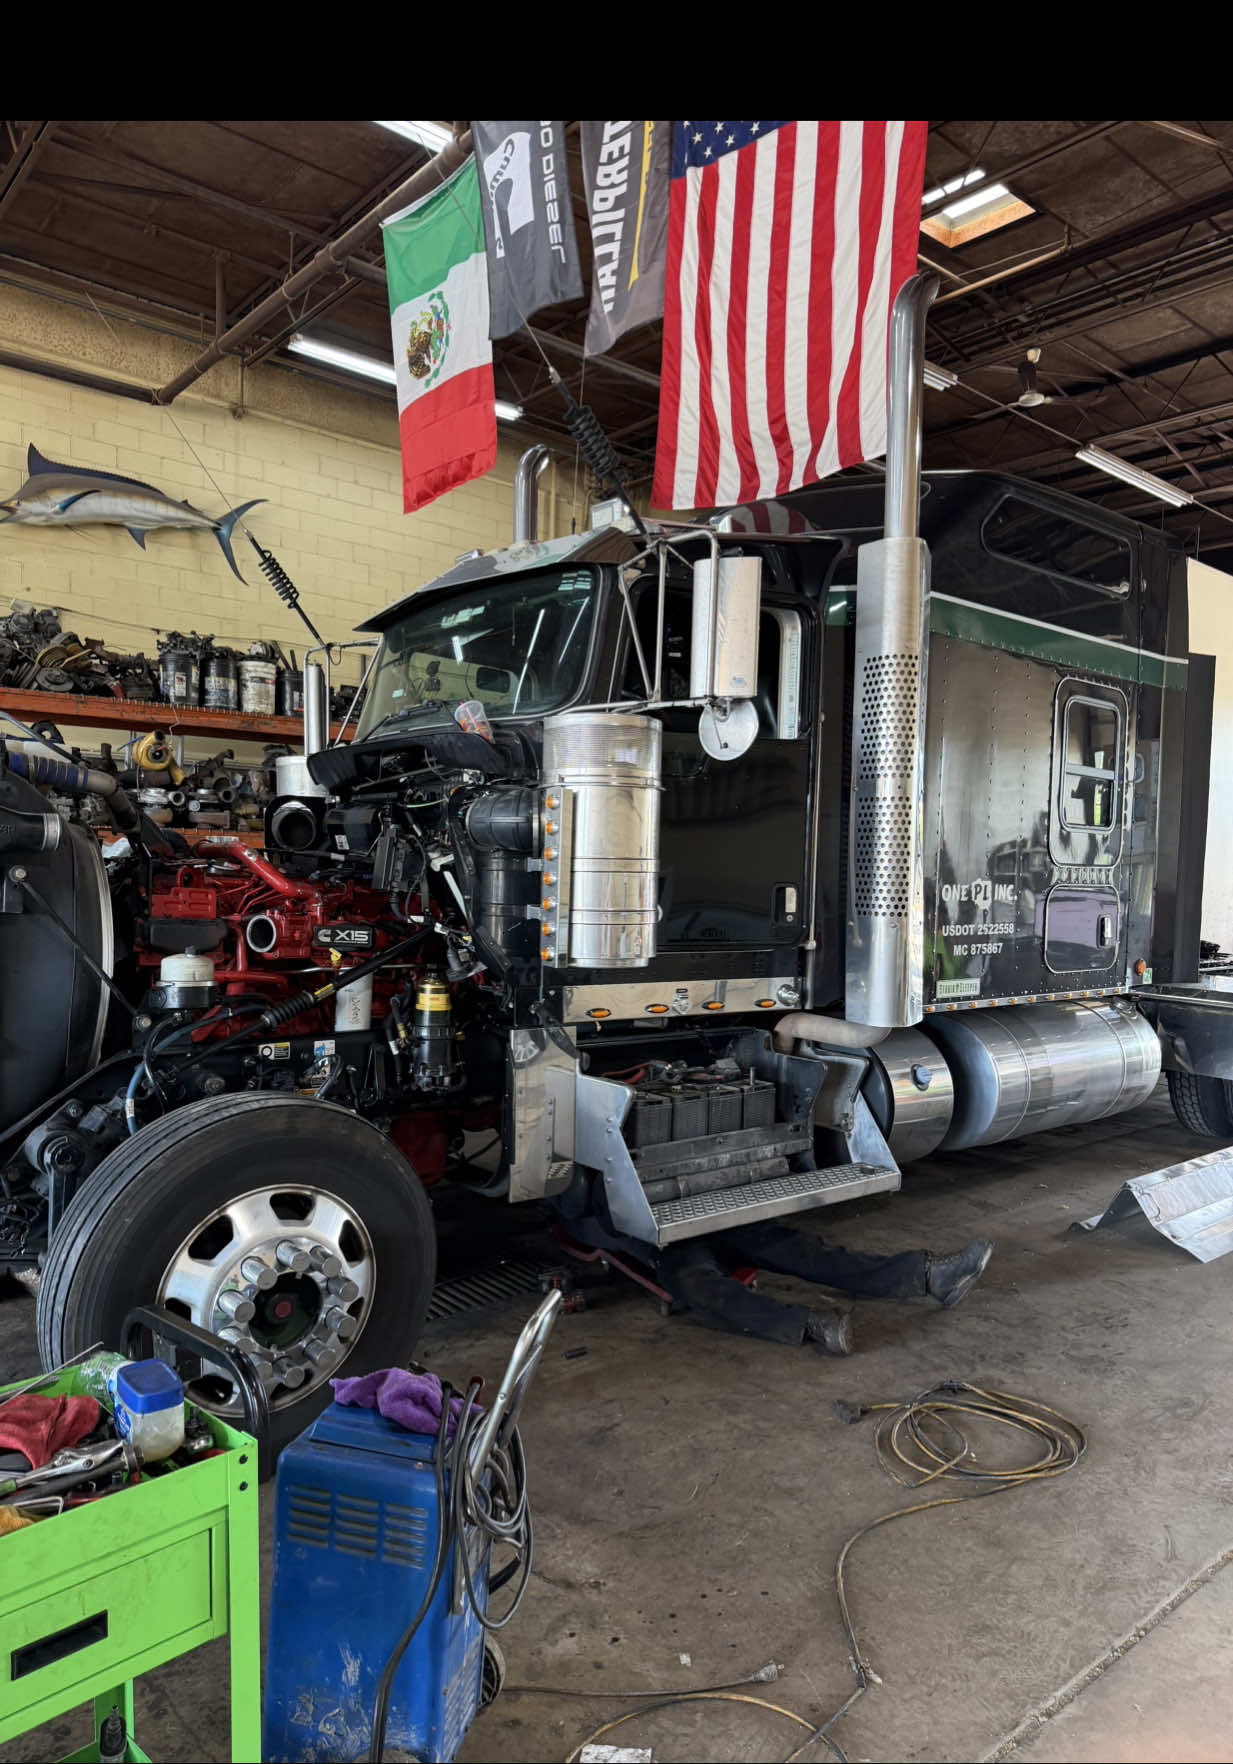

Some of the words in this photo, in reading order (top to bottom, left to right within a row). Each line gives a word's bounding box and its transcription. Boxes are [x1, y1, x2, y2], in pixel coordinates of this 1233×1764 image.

[942, 884, 968, 901] ONE
[994, 884, 1017, 900] INC.
[335, 929, 369, 941] X15
[942, 925, 975, 936] USDOT
[977, 923, 1014, 935] 2522558
[953, 944, 969, 956] MC
